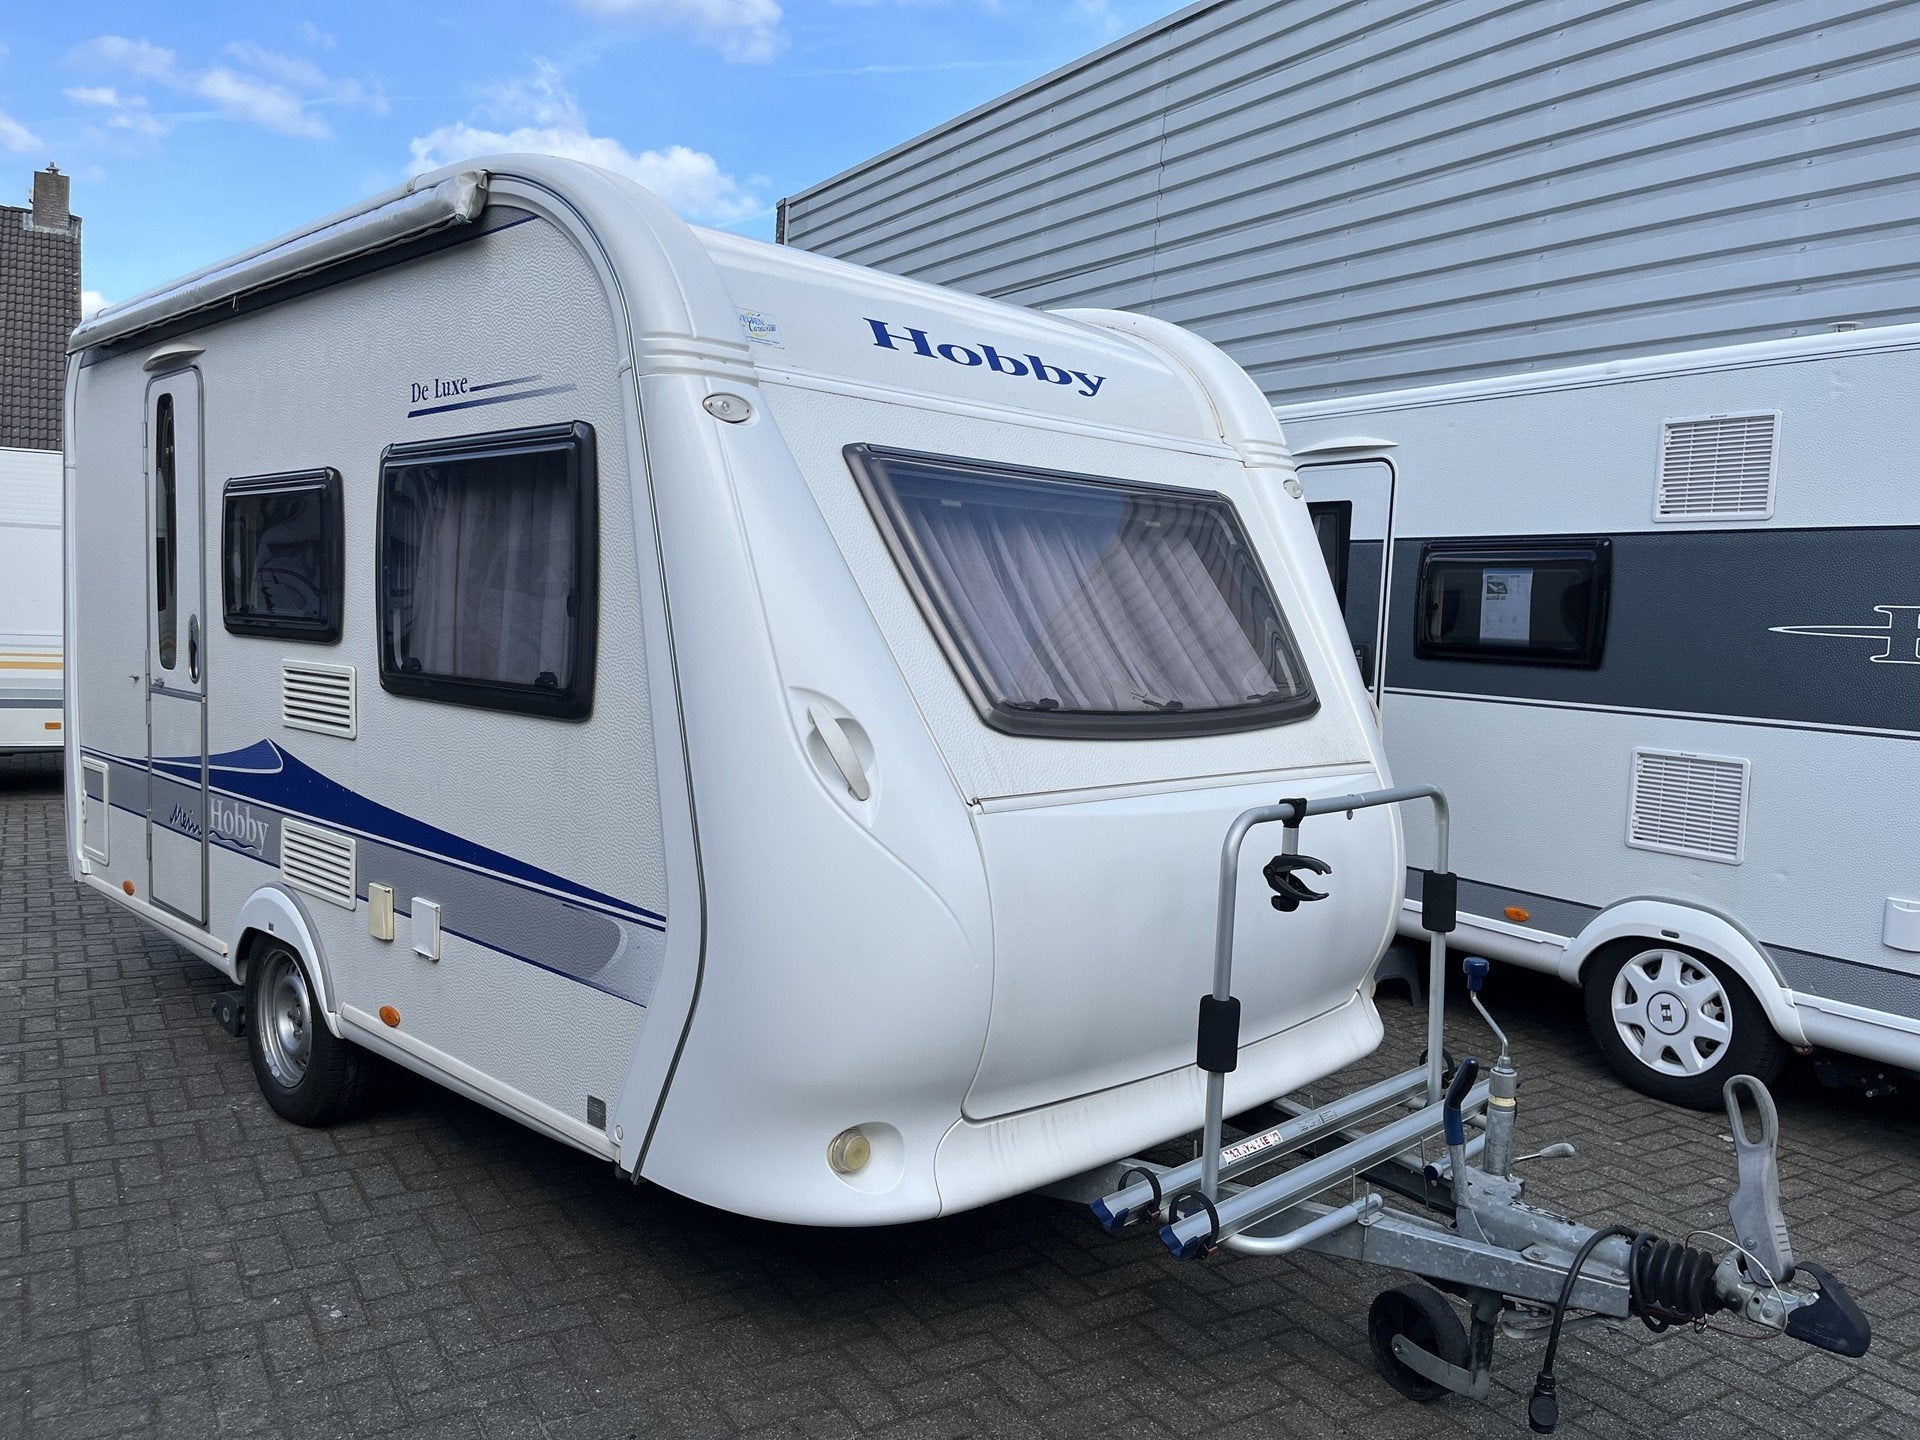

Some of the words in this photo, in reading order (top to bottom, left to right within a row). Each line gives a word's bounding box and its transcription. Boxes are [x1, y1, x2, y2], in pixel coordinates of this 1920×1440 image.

[863, 317, 1107, 397] Hobby
[411, 382, 429, 403] De
[435, 377, 468, 399] Luxe
[209, 797, 269, 856] Hobby
